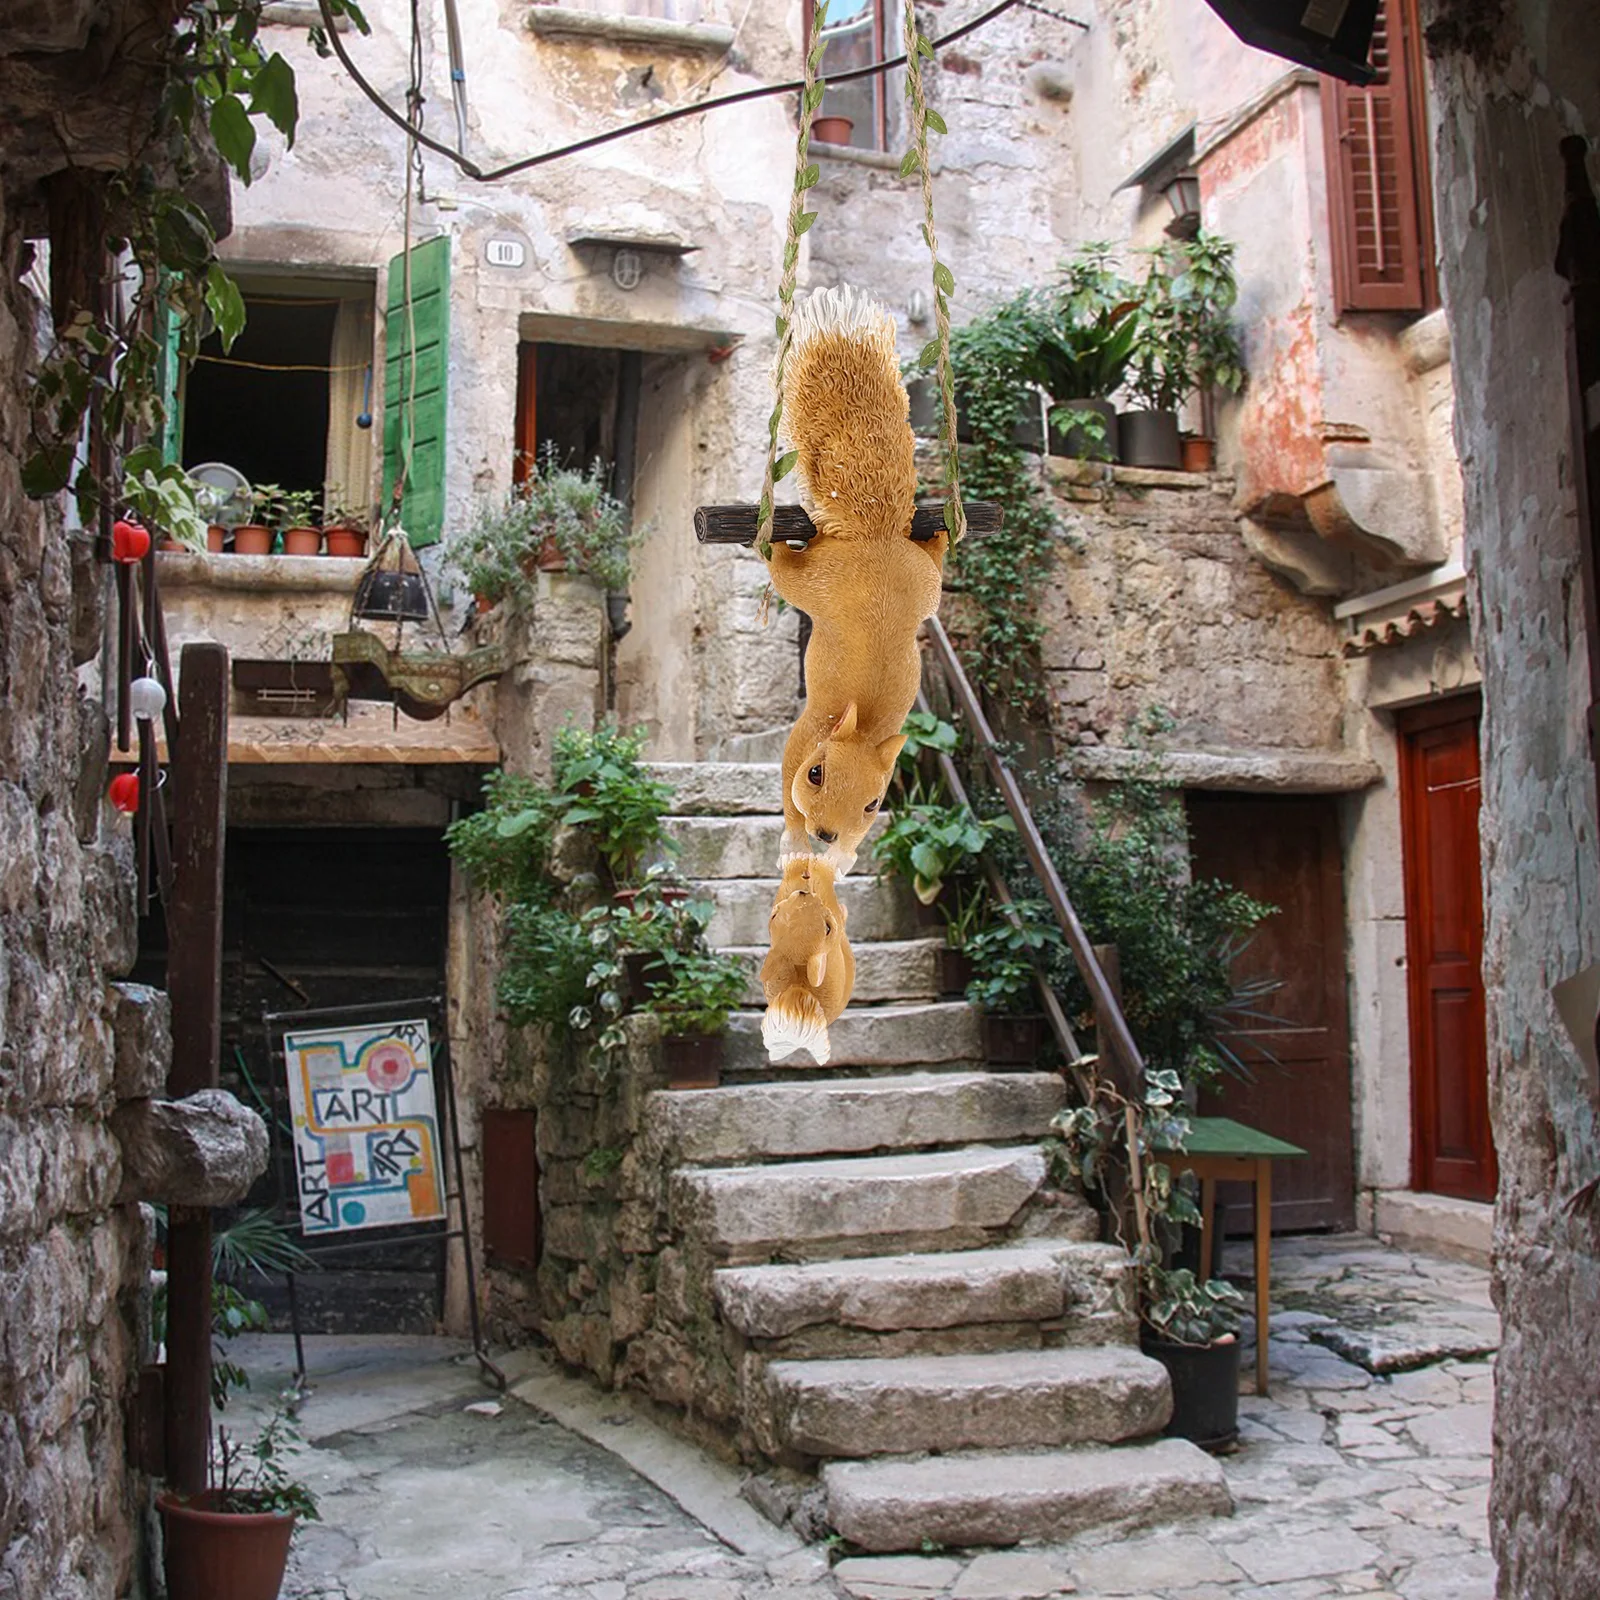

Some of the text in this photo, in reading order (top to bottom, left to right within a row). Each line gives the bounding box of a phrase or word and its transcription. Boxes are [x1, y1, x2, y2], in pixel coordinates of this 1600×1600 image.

[498, 244, 513, 261] 10
[388, 1024, 427, 1053] ART
[324, 1088, 390, 1124] ART
[372, 1129, 420, 1177] ART
[298, 1144, 331, 1224] ART
